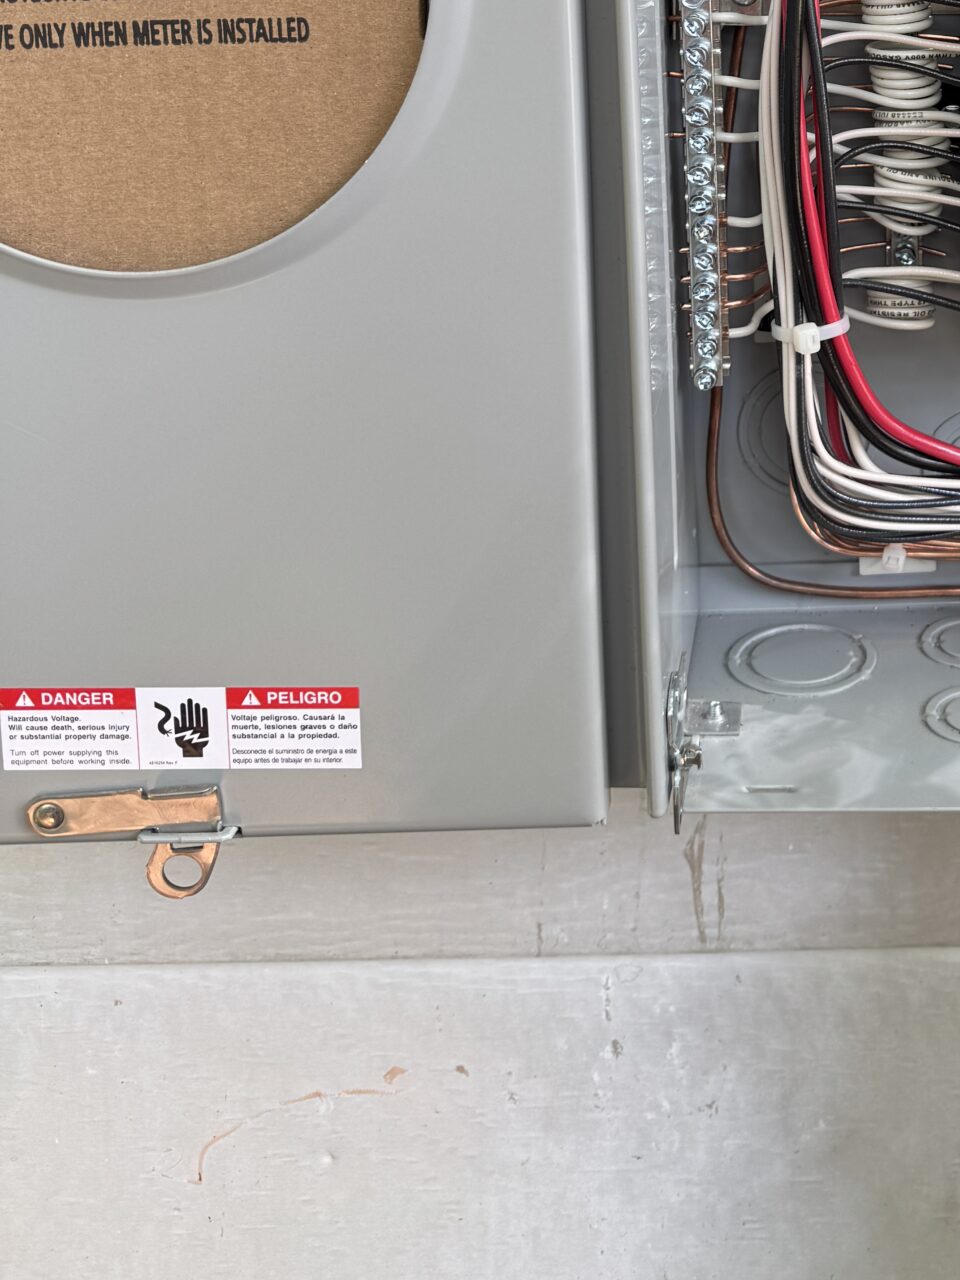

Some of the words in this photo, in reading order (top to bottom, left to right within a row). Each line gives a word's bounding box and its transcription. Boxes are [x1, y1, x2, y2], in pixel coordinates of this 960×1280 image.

[19, 23, 66, 49] ONLY
[71, 21, 128, 48] WHEN
[132, 19, 193, 46] METER
[197, 19, 213, 45] IS
[217, 17, 309, 44] INSTALLED
[41, 692, 113, 705] DANGER
[267, 691, 342, 704] PELIGRO
[231, 714, 257, 722] Voltaje
